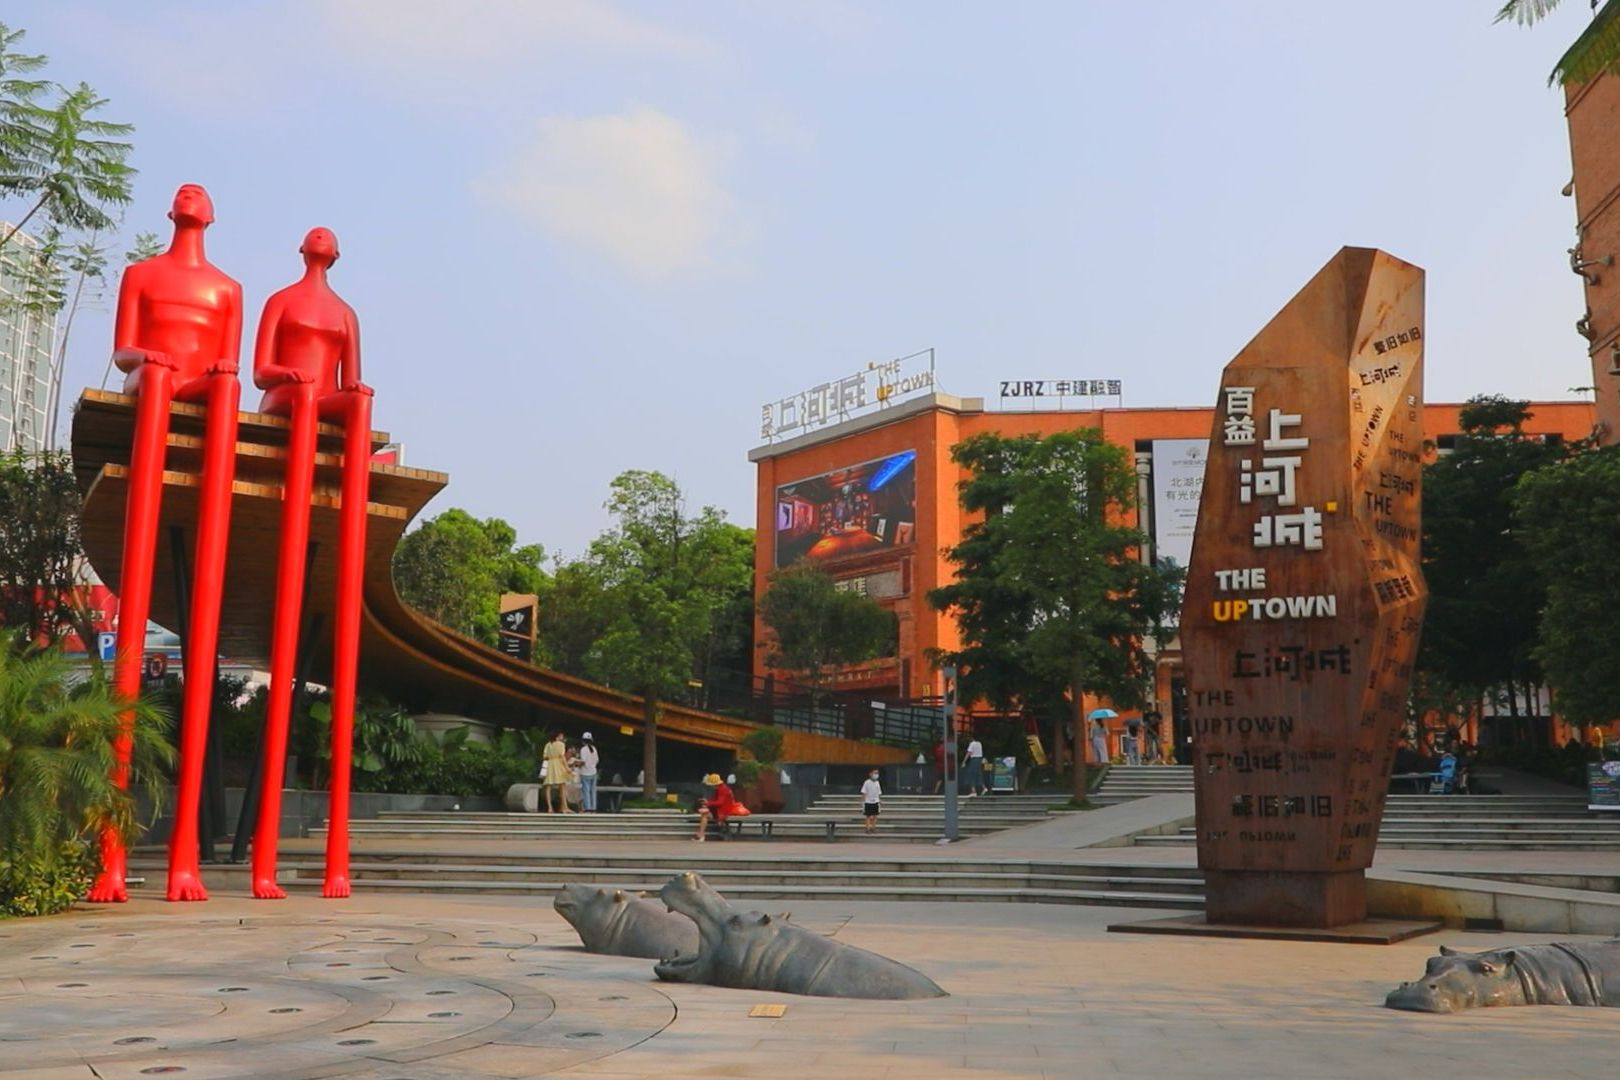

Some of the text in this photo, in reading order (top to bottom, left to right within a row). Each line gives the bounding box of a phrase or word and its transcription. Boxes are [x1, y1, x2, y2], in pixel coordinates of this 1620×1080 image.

[877, 359, 901, 377] THE
[876, 369, 935, 401] UPTOWN
[1000, 381, 1044, 397] ZJRZ
[1224, 386, 1256, 446] 百益
[1240, 408, 1338, 551] 上河城
[1364, 491, 1392, 515] THE
[1375, 518, 1417, 542] UPTOWN
[1215, 567, 1266, 591] THE
[1213, 595, 1336, 622] UPTOWN
[98, 634, 114, 660] P
[1194, 691, 1235, 706] THE
[1193, 717, 1294, 735] UPTOWN
